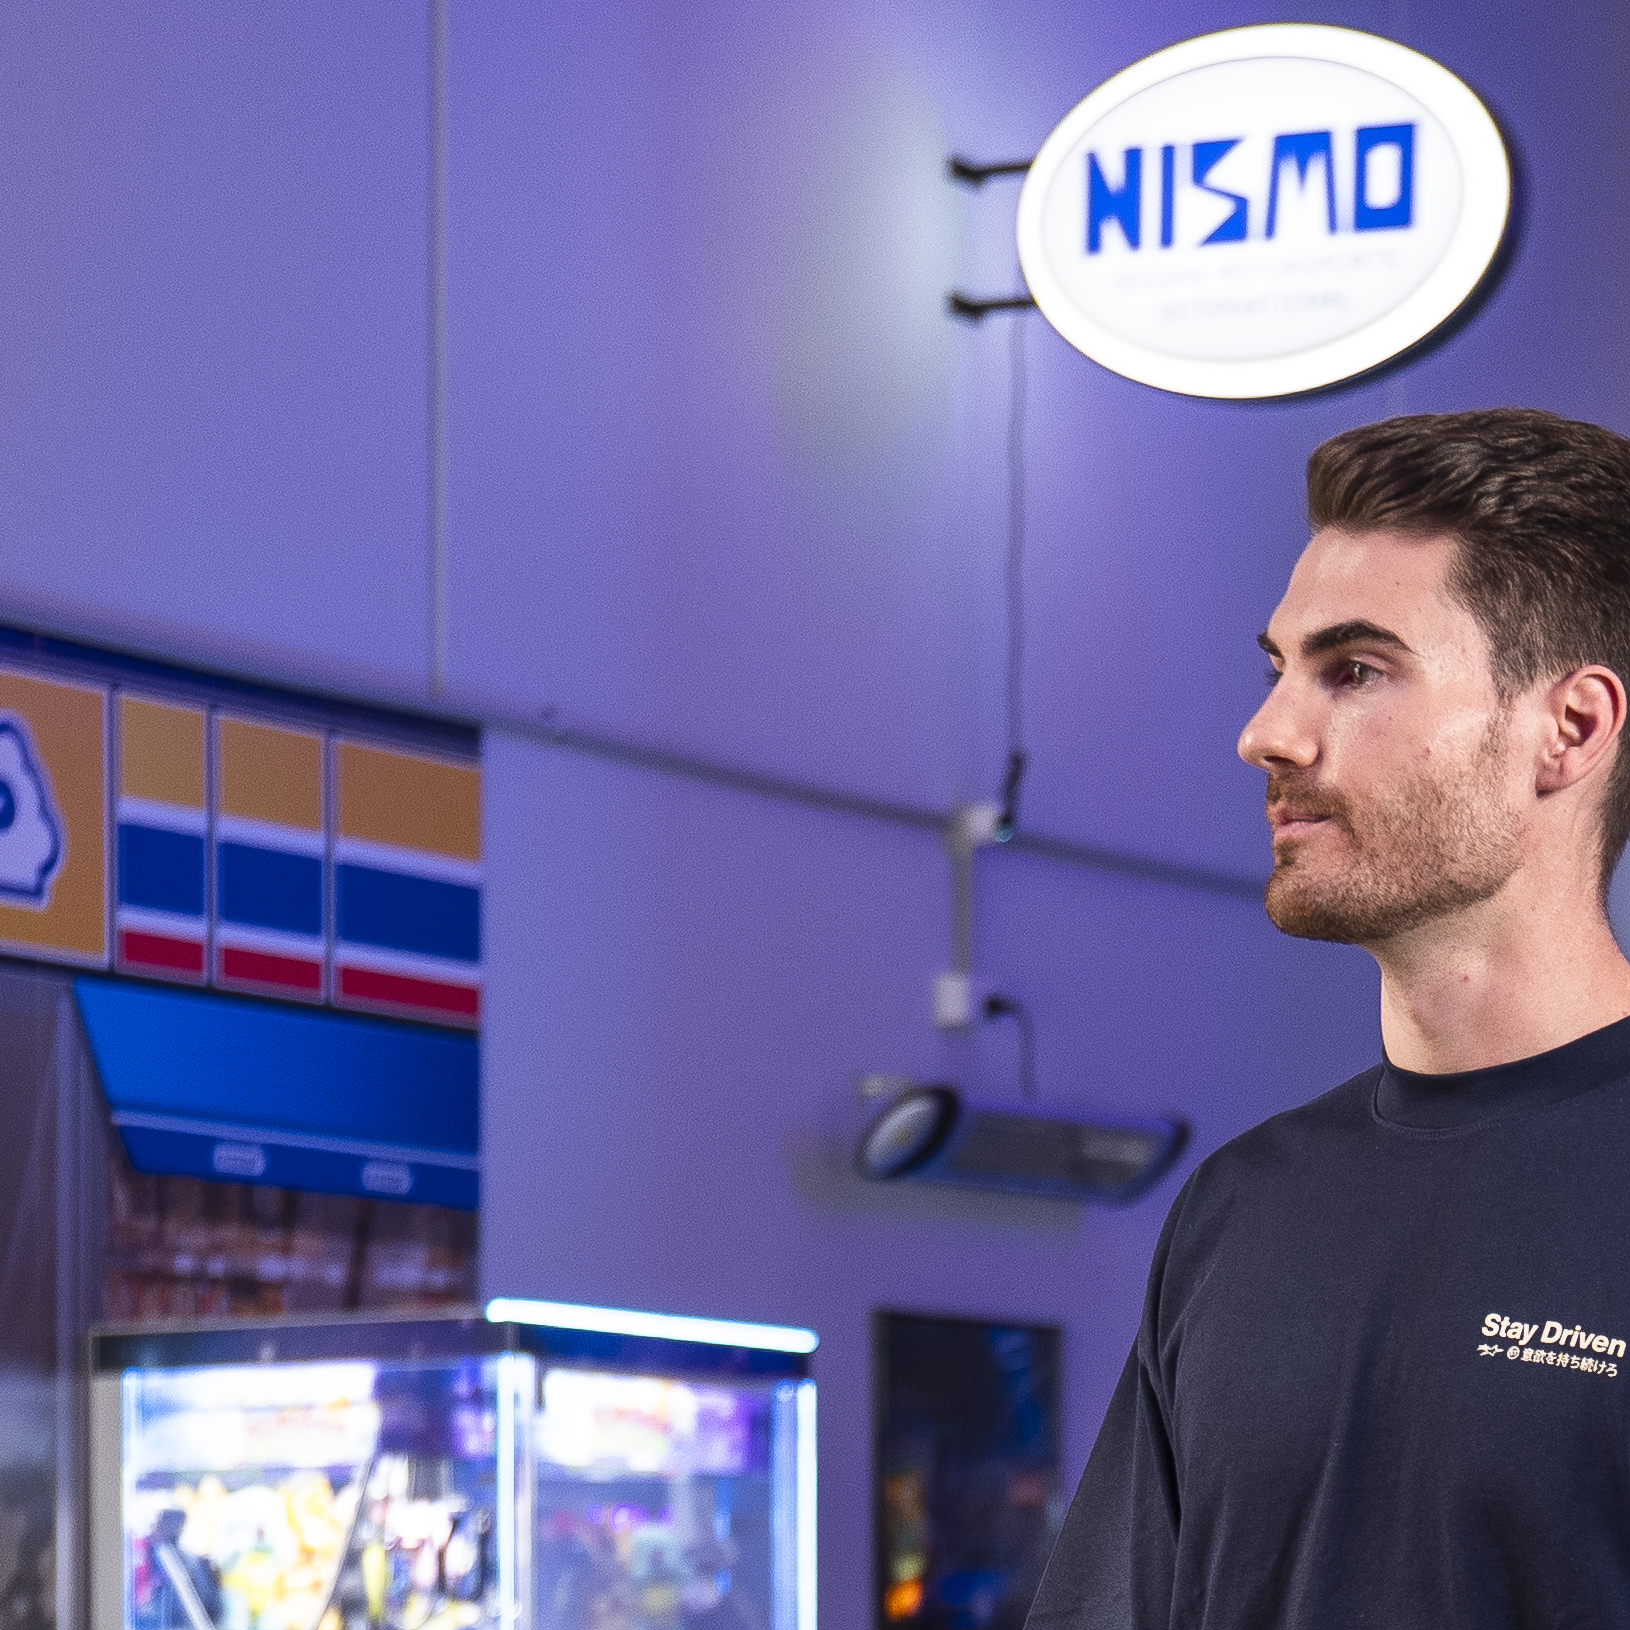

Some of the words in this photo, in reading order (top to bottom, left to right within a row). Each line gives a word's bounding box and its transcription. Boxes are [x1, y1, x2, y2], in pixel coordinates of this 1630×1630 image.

[1085, 122, 1415, 256] NISMO
[1481, 1312, 1540, 1346] Stay
[1540, 1320, 1627, 1358] Driven
